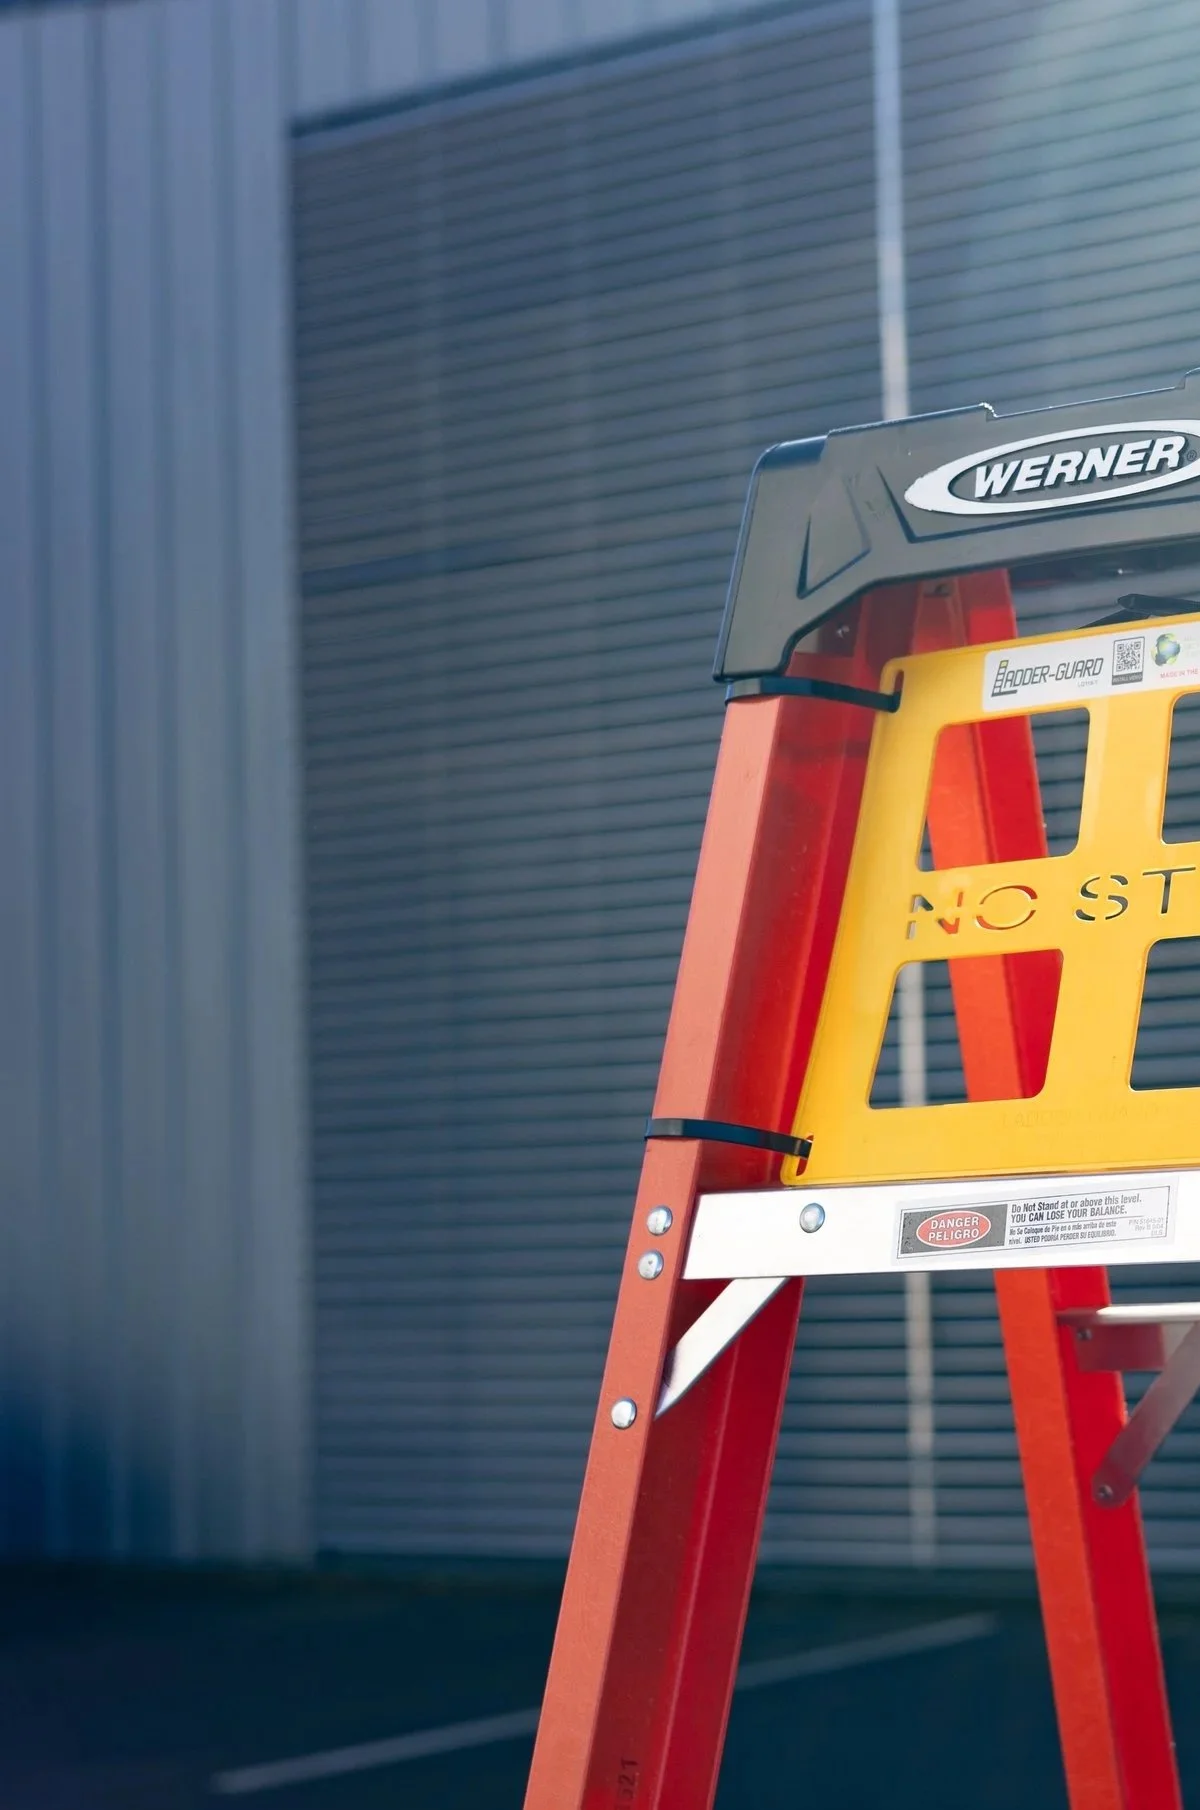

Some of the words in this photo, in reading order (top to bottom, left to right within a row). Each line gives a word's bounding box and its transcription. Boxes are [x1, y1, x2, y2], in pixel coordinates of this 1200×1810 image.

[974, 435, 1187, 499] WERNER
[1187, 667, 1199, 675] THE
[905, 884, 1038, 940] NO
[1011, 1203, 1022, 1214] Do
[1024, 1202, 1036, 1212] Not
[1038, 1201, 1060, 1211] Stand
[1061, 1200, 1069, 1209] at
[1070, 1200, 1079, 1209] or
[1080, 1198, 1103, 1207] above
[1104, 1195, 1119, 1205] this
[1121, 1193, 1142, 1203] level.
[1011, 1213, 1026, 1223] YOU
[1029, 1212, 1044, 1222] CAN
[1046, 1210, 1065, 1220] LOSE
[1067, 1208, 1088, 1218] YOUR
[1090, 1205, 1127, 1216] BALANCE.
[930, 1216, 980, 1230] DANGER
[928, 1228, 980, 1242] PELIGRO
[1024, 1235, 1040, 1244] USTED
